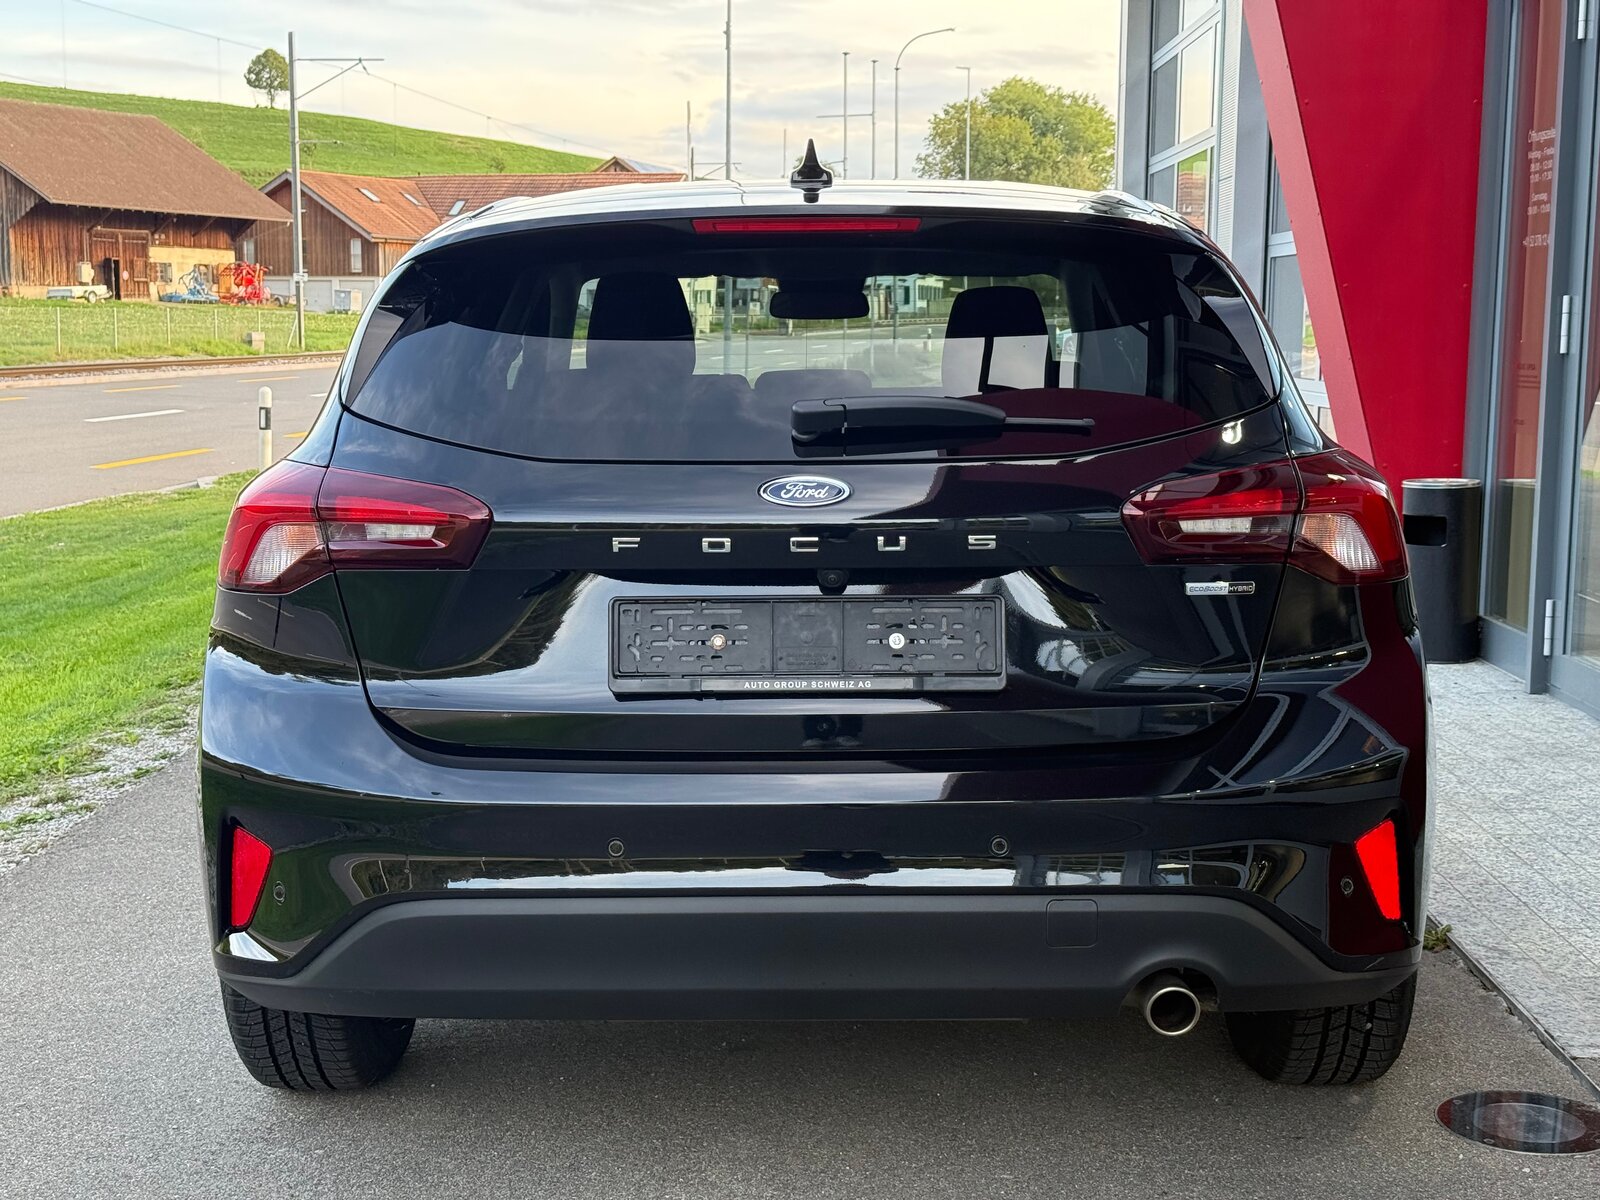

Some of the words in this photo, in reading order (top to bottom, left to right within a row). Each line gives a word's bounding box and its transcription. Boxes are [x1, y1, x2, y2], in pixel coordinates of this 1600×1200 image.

[781, 482, 829, 499] Ford
[612, 535, 997, 553] FOCUS
[744, 681, 770, 689] AUTO
[774, 681, 808, 689] GROUP
[858, 680, 872, 688] AG
